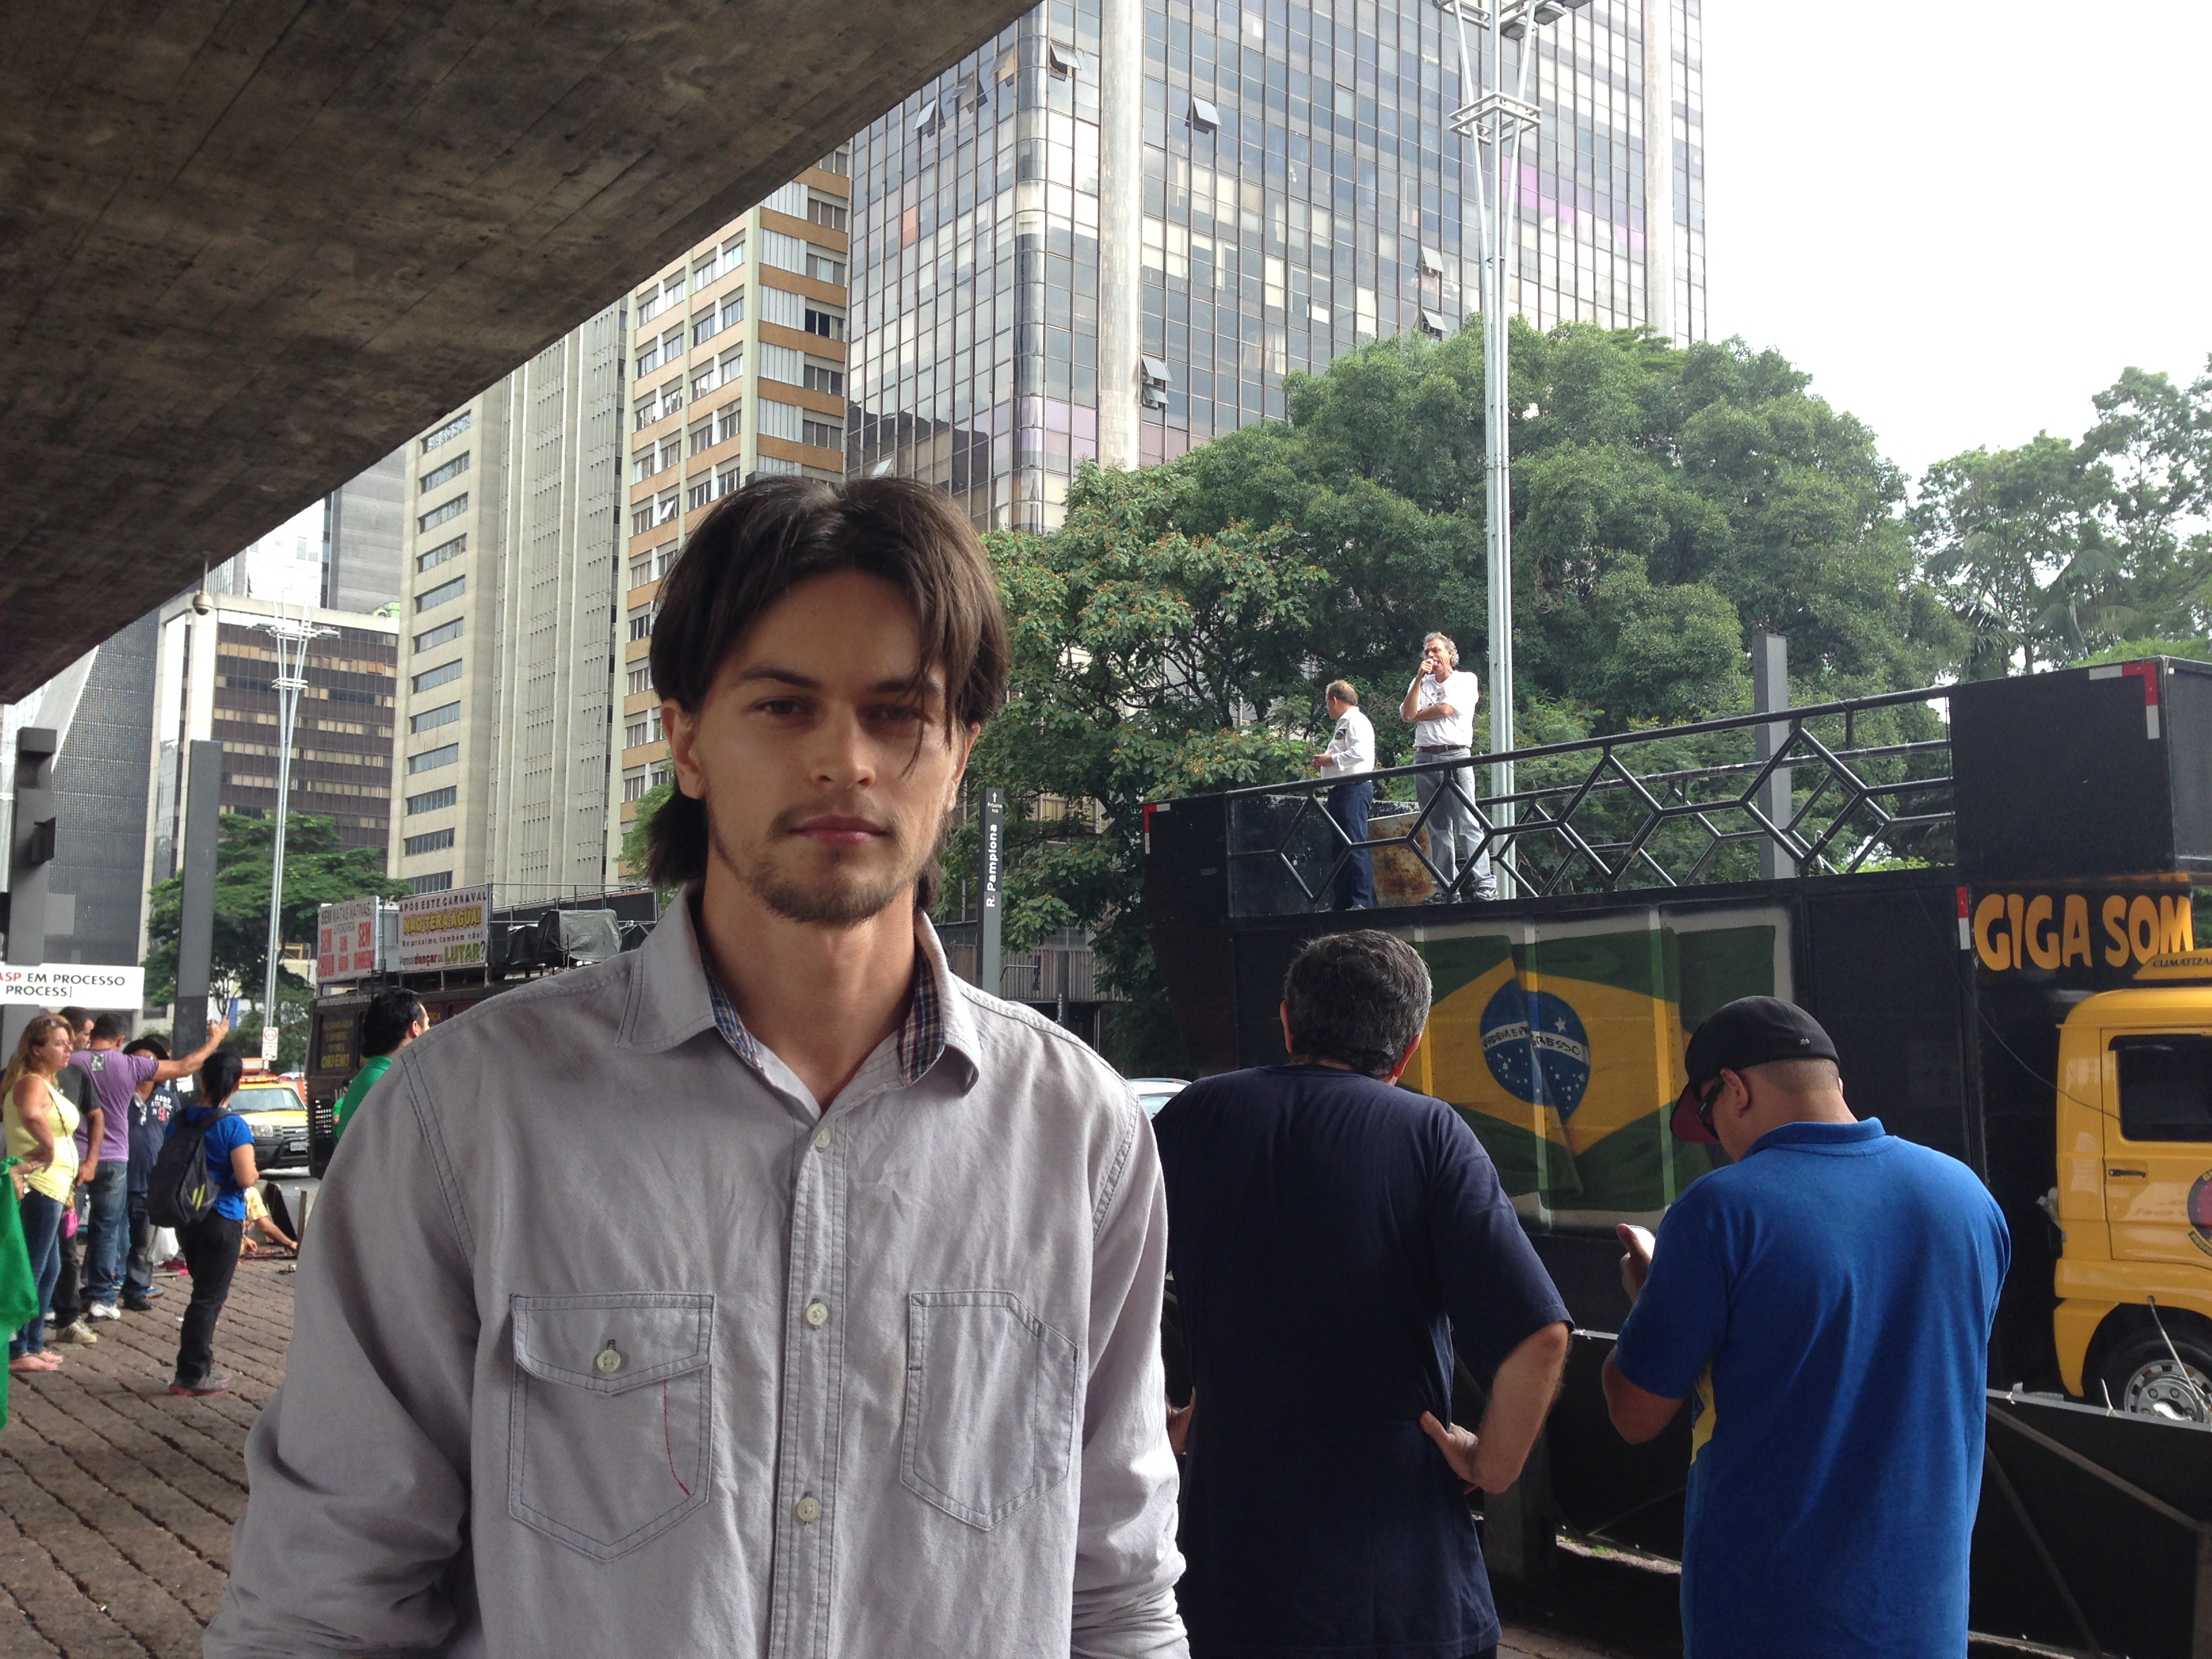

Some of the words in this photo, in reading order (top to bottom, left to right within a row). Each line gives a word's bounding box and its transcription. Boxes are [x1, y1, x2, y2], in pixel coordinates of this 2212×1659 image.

[987, 824, 999, 892] Pamplona
[399, 901, 419, 912] APÓS
[421, 898, 441, 909] ESTE
[443, 892, 487, 906] CARNAVAL
[986, 895, 996, 907] R.
[358, 922, 371, 948] SEM
[1974, 893, 2093, 971] GIGA
[2102, 895, 2194, 968] SOM
[414, 954, 437, 966] dançar
[28, 972, 47, 983] EM
[54, 974, 125, 986] PROCESSO
